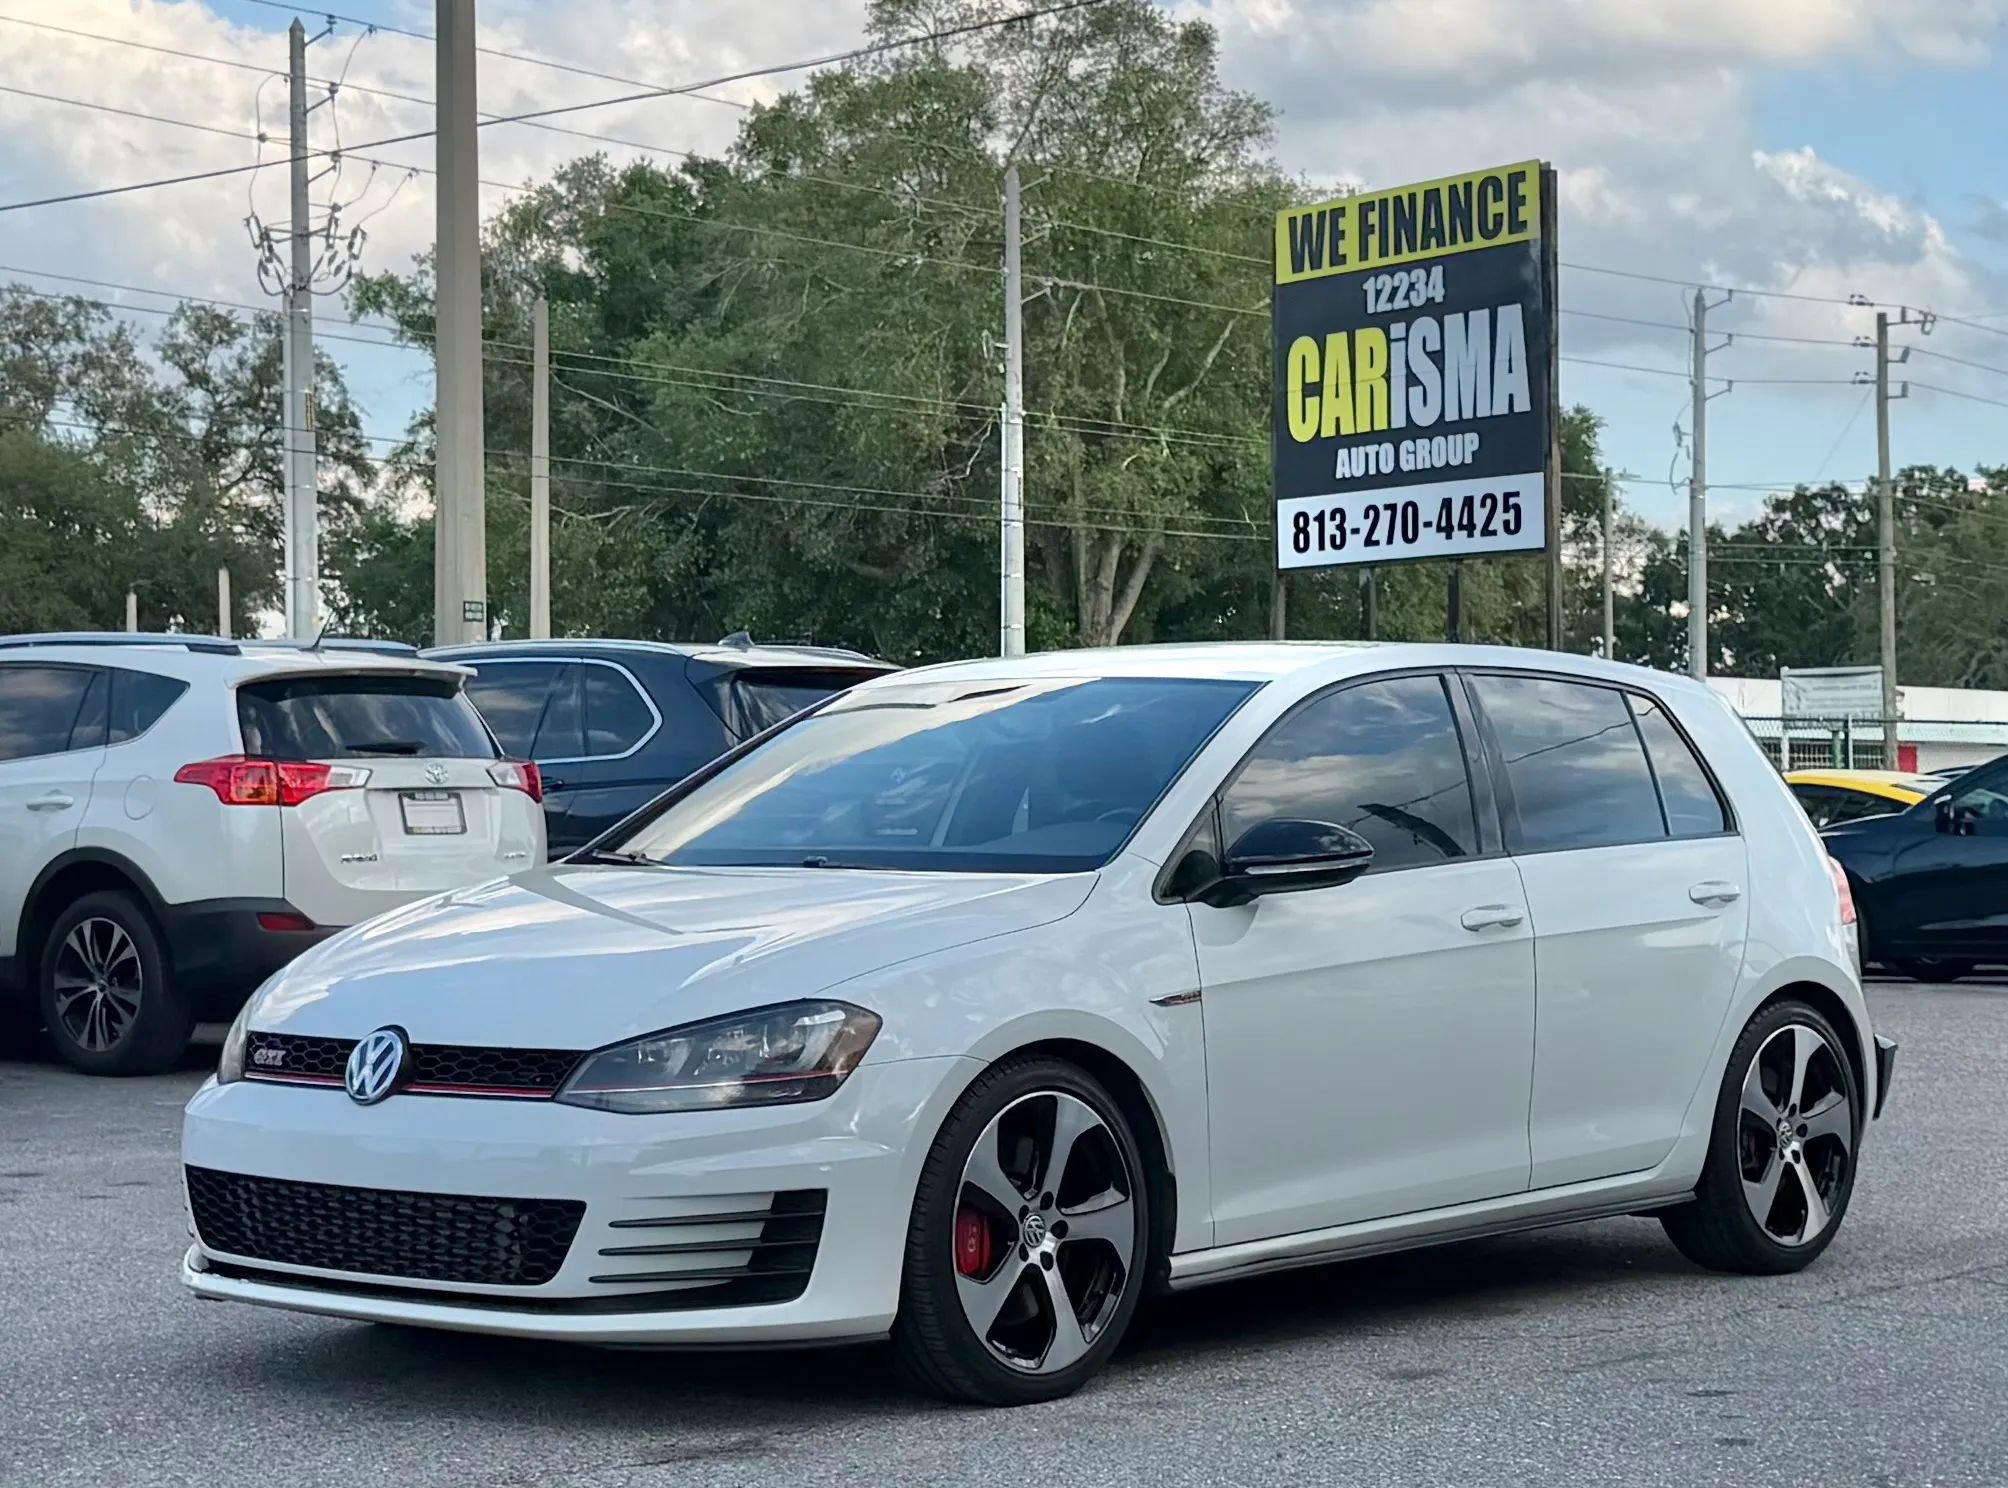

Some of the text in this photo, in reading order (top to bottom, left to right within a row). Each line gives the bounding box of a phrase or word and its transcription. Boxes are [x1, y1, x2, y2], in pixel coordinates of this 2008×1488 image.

[1288, 171, 1528, 274] WE FINANCE
[1362, 265, 1445, 314] 12234
[1287, 303, 1531, 443] CARiSMA
[1336, 432, 1480, 479] AUTO GROUP
[1292, 490, 1523, 553] 813-270-4425
